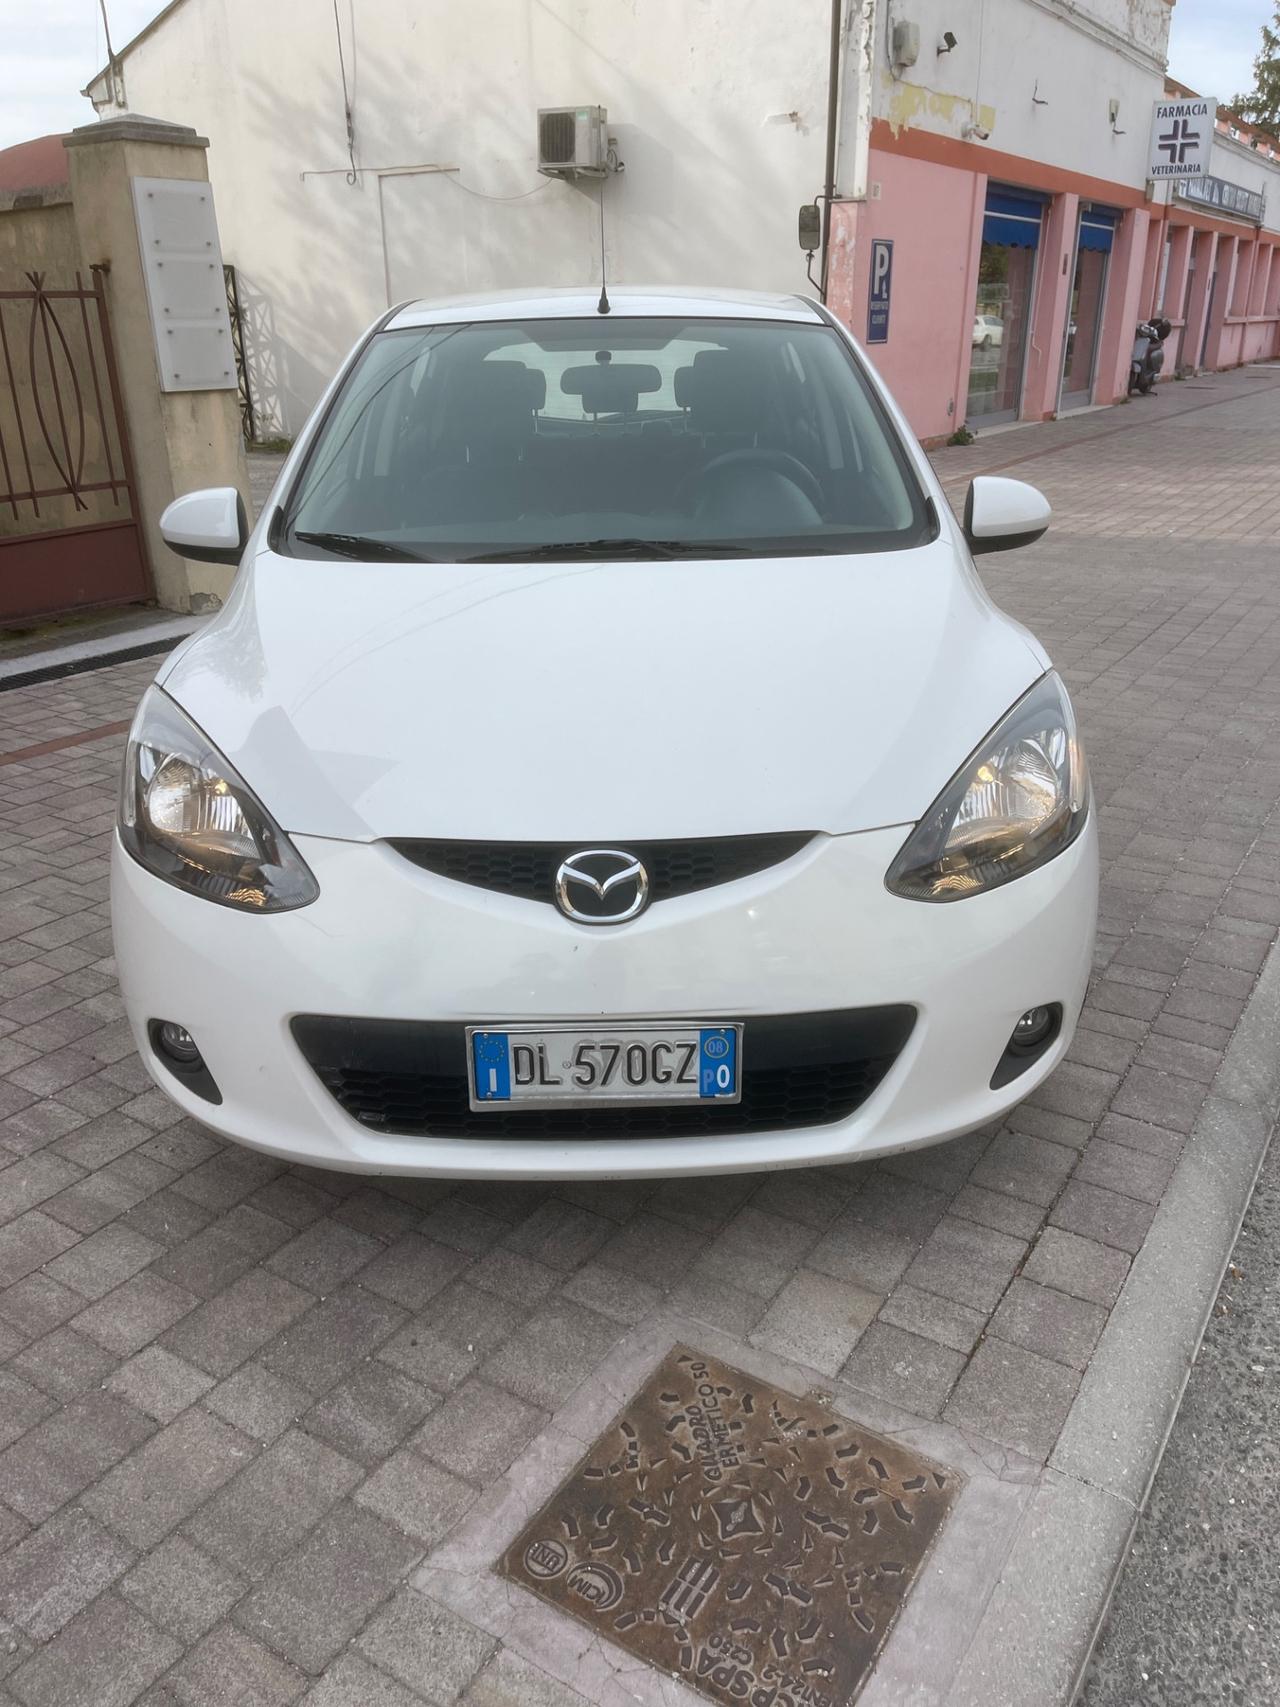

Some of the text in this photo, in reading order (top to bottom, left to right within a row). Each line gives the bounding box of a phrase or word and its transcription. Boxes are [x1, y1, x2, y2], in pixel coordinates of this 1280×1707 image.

[1157, 104, 1208, 119] FARMACIA
[1152, 164, 1201, 175] VETERINARIA
[874, 245, 889, 294] P
[708, 1040, 725, 1054] 08
[489, 1068, 498, 1093] I
[513, 1044, 561, 1086] DL
[690, 1362, 740, 1468] ERMETICO 50
[698, 1647, 755, 1697] SPA
